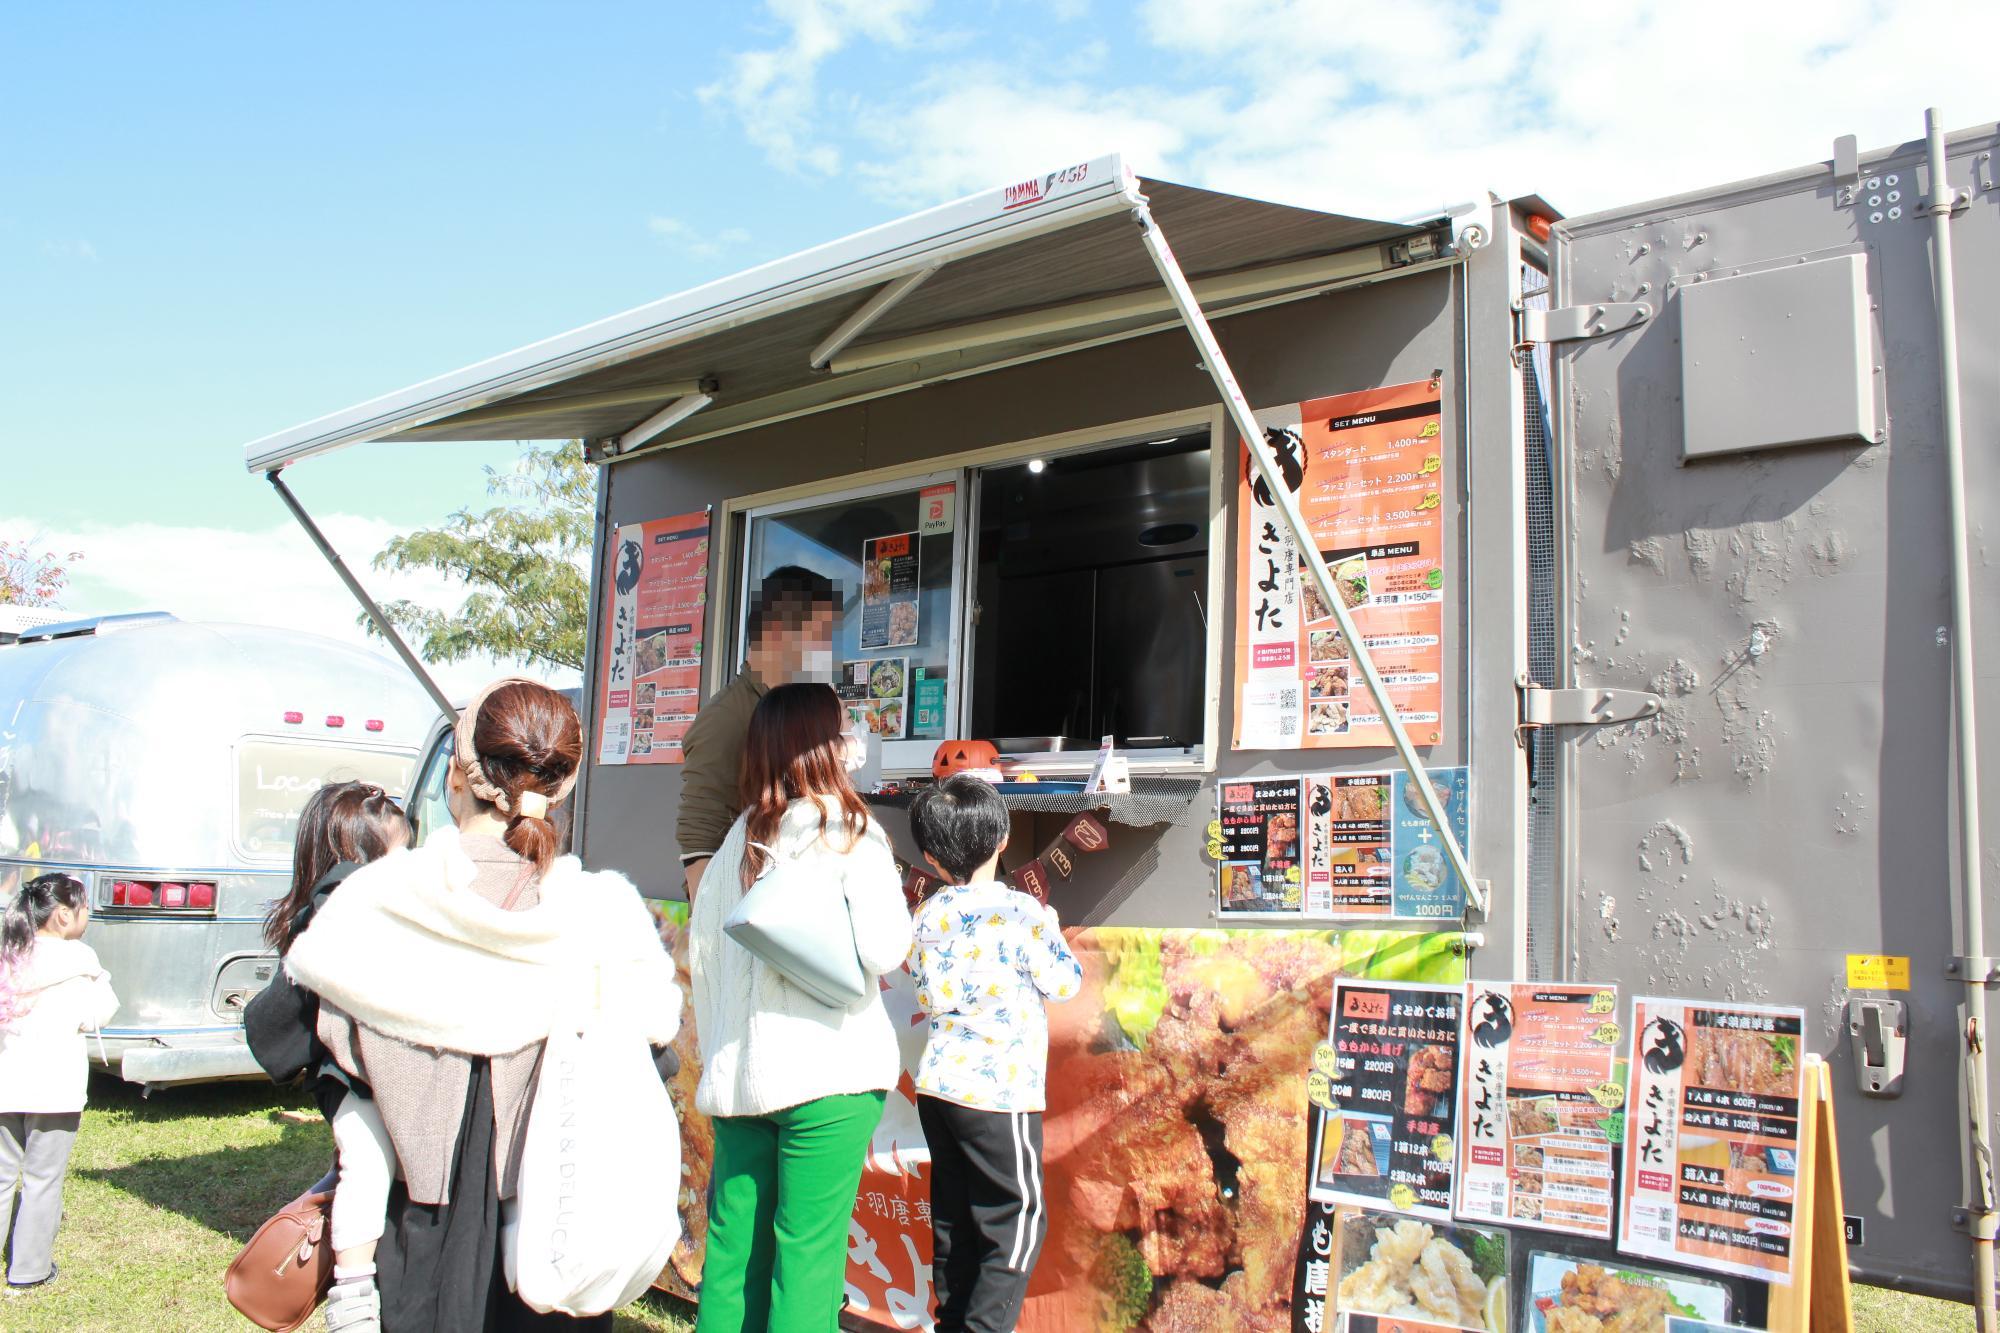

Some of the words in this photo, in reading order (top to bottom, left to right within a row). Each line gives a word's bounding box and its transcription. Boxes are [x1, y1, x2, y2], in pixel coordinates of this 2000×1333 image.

[1005, 179, 1040, 203] FIAMMA
[1334, 419, 1350, 428] SET
[1352, 415, 1376, 425] MENU
[1322, 445, 1367, 459] スタンダード
[1321, 477, 1382, 492] ファミリーセット
[924, 520, 947, 529] PayPay
[1319, 514, 1380, 528] パーティーセット
[1371, 548, 1386, 557] 単品
[1387, 546, 1413, 556] MENU
[1254, 521, 1282, 632] きよた
[611, 606, 627, 683] きよた
[1312, 822, 1324, 867] きよた
[1415, 904, 1453, 916] 1000円
[1392, 1004, 1456, 1019] まとめてお得
[1338, 1039, 1404, 1056] ももから揚げ
[1335, 1057, 1355, 1070] 15個
[1364, 1059, 1394, 1074] 2200円
[1332, 1085, 1352, 1097] 20個
[1361, 1088, 1392, 1102] 2800円
[1472, 1058, 1495, 1138] きよた
[1601, 1084, 1623, 1097] 400円
[1688, 1092, 1712, 1104] 1人前
[1715, 1096, 1730, 1106] 4本
[1733, 1097, 1757, 1109] 600円
[1641, 1084, 1664, 1164] きよた
[1685, 1113, 1711, 1125] 2人前
[1714, 1117, 1729, 1127] 8本
[1733, 1119, 1760, 1131] 1200円
[1393, 1141, 1429, 1156] 1箱12本
[1423, 1159, 1452, 1174] 1700円
[1684, 1167, 1719, 1183] 箱入り
[1390, 1169, 1426, 1186] 2箱24本
[1419, 1189, 1450, 1204] 3200円
[1681, 1191, 1708, 1204] 3人前
[1711, 1196, 1730, 1208] 12本
[1733, 1199, 1761, 1212] 1700円
[1680, 1223, 1706, 1237] 6人前
[1708, 1229, 1728, 1241] 24本
[1731, 1232, 1758, 1246] 3200円
